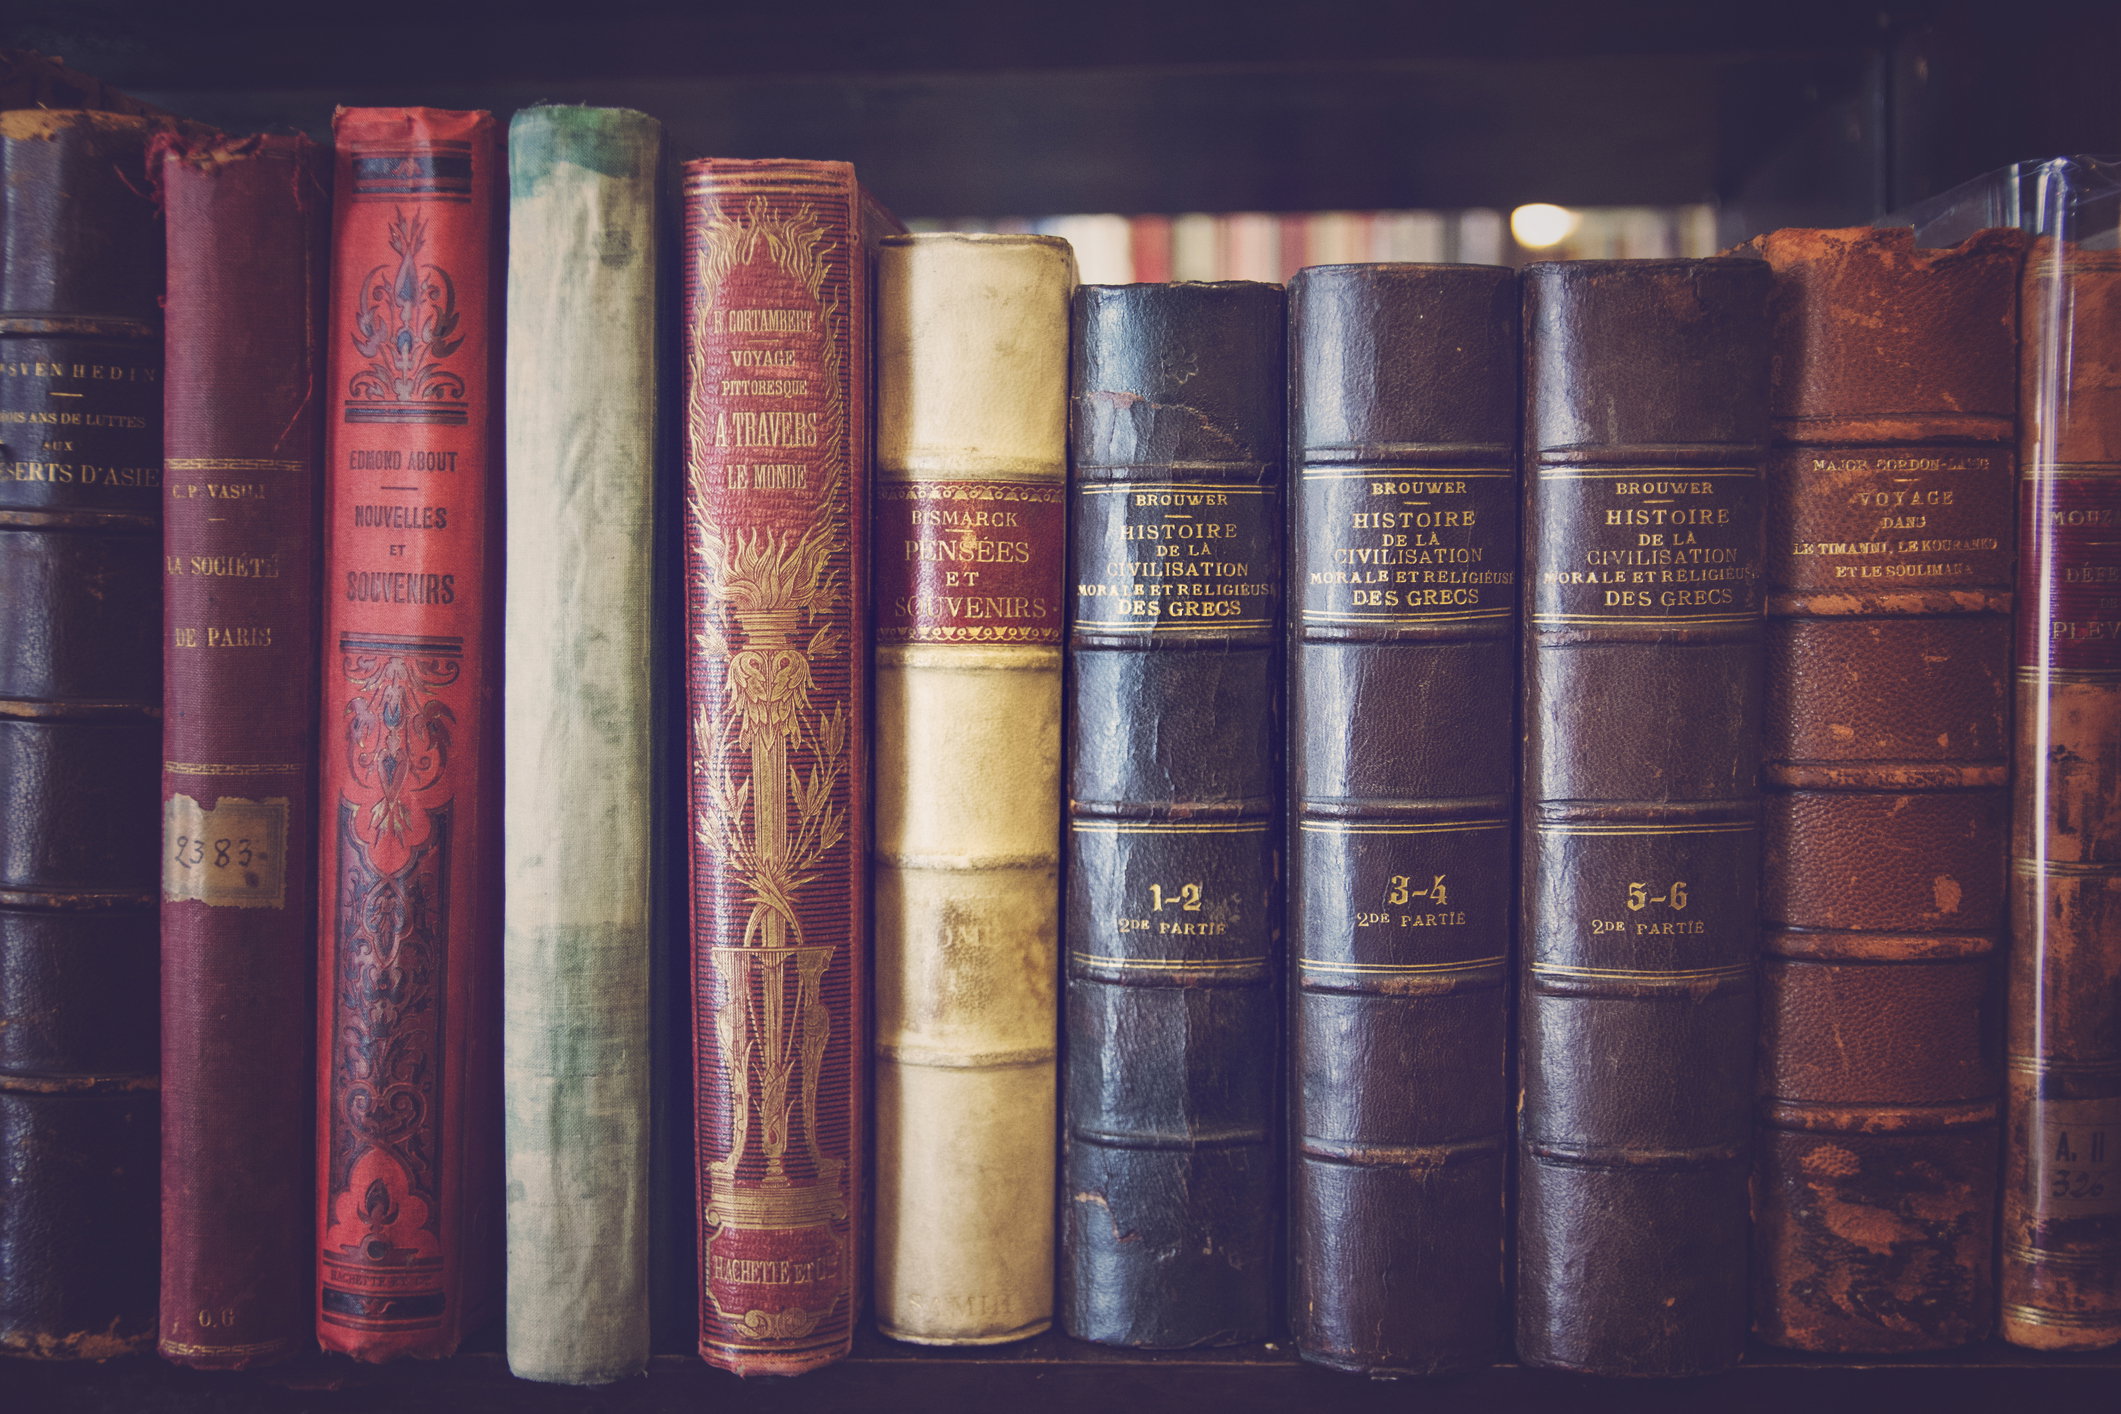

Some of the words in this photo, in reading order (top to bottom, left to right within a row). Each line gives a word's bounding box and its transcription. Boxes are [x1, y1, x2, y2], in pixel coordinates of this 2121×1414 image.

[729, 309, 813, 334] CORTAMBERT
[731, 350, 796, 367] VOYAGE
[73, 364, 157, 382] HEDIN
[722, 380, 809, 399] PITTORESQUE
[29, 412, 57, 424] ANS
[60, 413, 81, 424] DE
[86, 414, 146, 428] LUTTES
[715, 412, 728, 448] A
[733, 412, 817, 448] TRAVERS
[349, 450, 401, 470] EDMOND
[408, 452, 458, 472] ABOUT
[81, 464, 159, 487] D'ASIE
[726, 464, 749, 490] LE
[753, 463, 807, 490] MONDE
[1372, 481, 1467, 495] BROUWER
[1615, 482, 1714, 495] BROUWER
[1136, 494, 1228, 507] BROUWER
[1857, 491, 1953, 506] VOYAGE
[355, 505, 448, 529] NOUVELLES
[911, 510, 1019, 527] BISMARCK
[1352, 510, 1476, 529] HISTOIRE
[1605, 508, 1729, 526] HISTOIRE
[1119, 523, 1238, 541] HISTOIRE
[1382, 534, 1407, 547] DE
[1638, 534, 1664, 547] DE
[389, 544, 406, 556] ET
[904, 537, 1030, 563] PENSÉES
[1156, 545, 1180, 557] DE
[1334, 547, 1484, 565] CIVILISATION
[1587, 548, 1737, 566] CIVILISATION
[1793, 543, 1814, 555] LE
[1898, 541, 1919, 552] LE
[946, 571, 980, 587] ET
[1107, 562, 1248, 578] CIVILISATION
[1311, 570, 1389, 585] MORALE
[1395, 571, 1419, 583] ET
[1632, 571, 1656, 583] ET
[1836, 566, 1857, 578] ET
[1861, 565, 1882, 578] LE
[346, 571, 455, 604] SOUVENIRS
[1078, 583, 1145, 597] MORALE
[1150, 584, 1173, 596] ET
[1351, 589, 1399, 606] DES
[1407, 588, 1479, 606] GRECS
[1604, 590, 1652, 607] DES
[1661, 588, 1733, 607] GRECS
[895, 596, 1047, 619] SOUVENIRS
[1117, 600, 1161, 616] DES
[1168, 600, 1242, 617] GRECS
[175, 628, 197, 648] DE
[207, 627, 272, 648] PARIS
[175, 836, 253, 869] 2383
[1149, 883, 1202, 912] 1-2
[1388, 874, 1448, 905] 3-4
[1627, 881, 1688, 911] 5-6
[714, 1255, 790, 1285] HACHETTE
